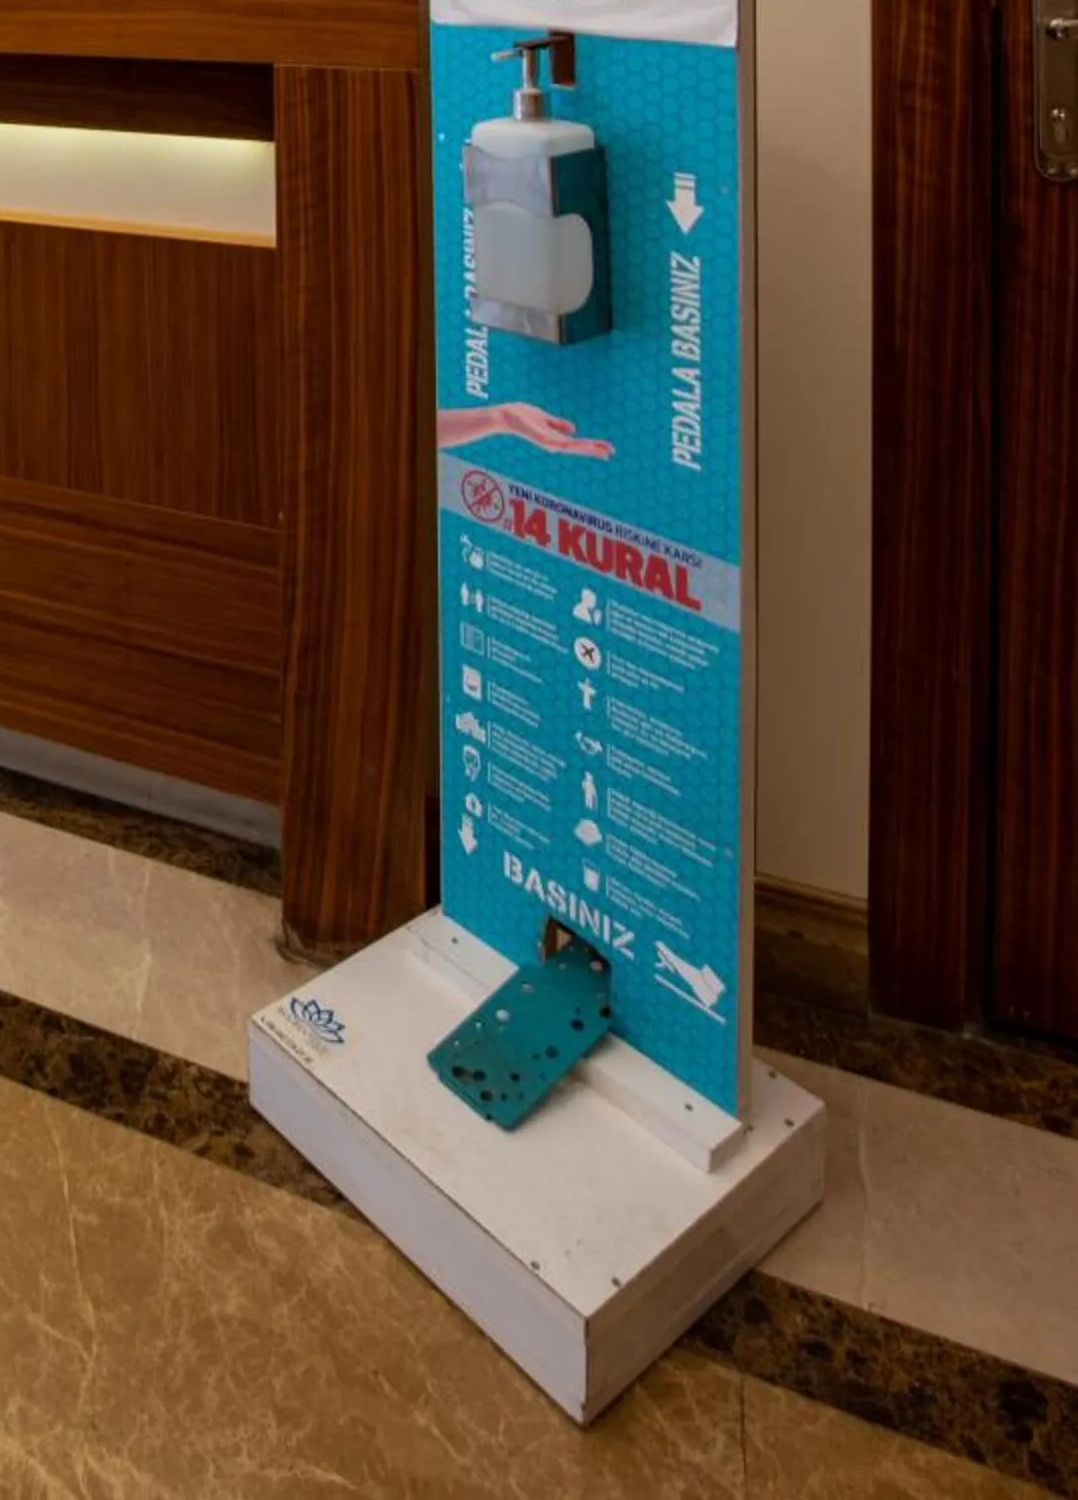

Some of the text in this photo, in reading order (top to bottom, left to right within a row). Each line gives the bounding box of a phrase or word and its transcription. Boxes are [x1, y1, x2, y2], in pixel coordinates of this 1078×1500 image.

[670, 250, 702, 472] PEDALA BASINIZ
[508, 497, 551, 549] 14
[557, 515, 703, 612] KURAL
[503, 850, 636, 961] BASINIZ
